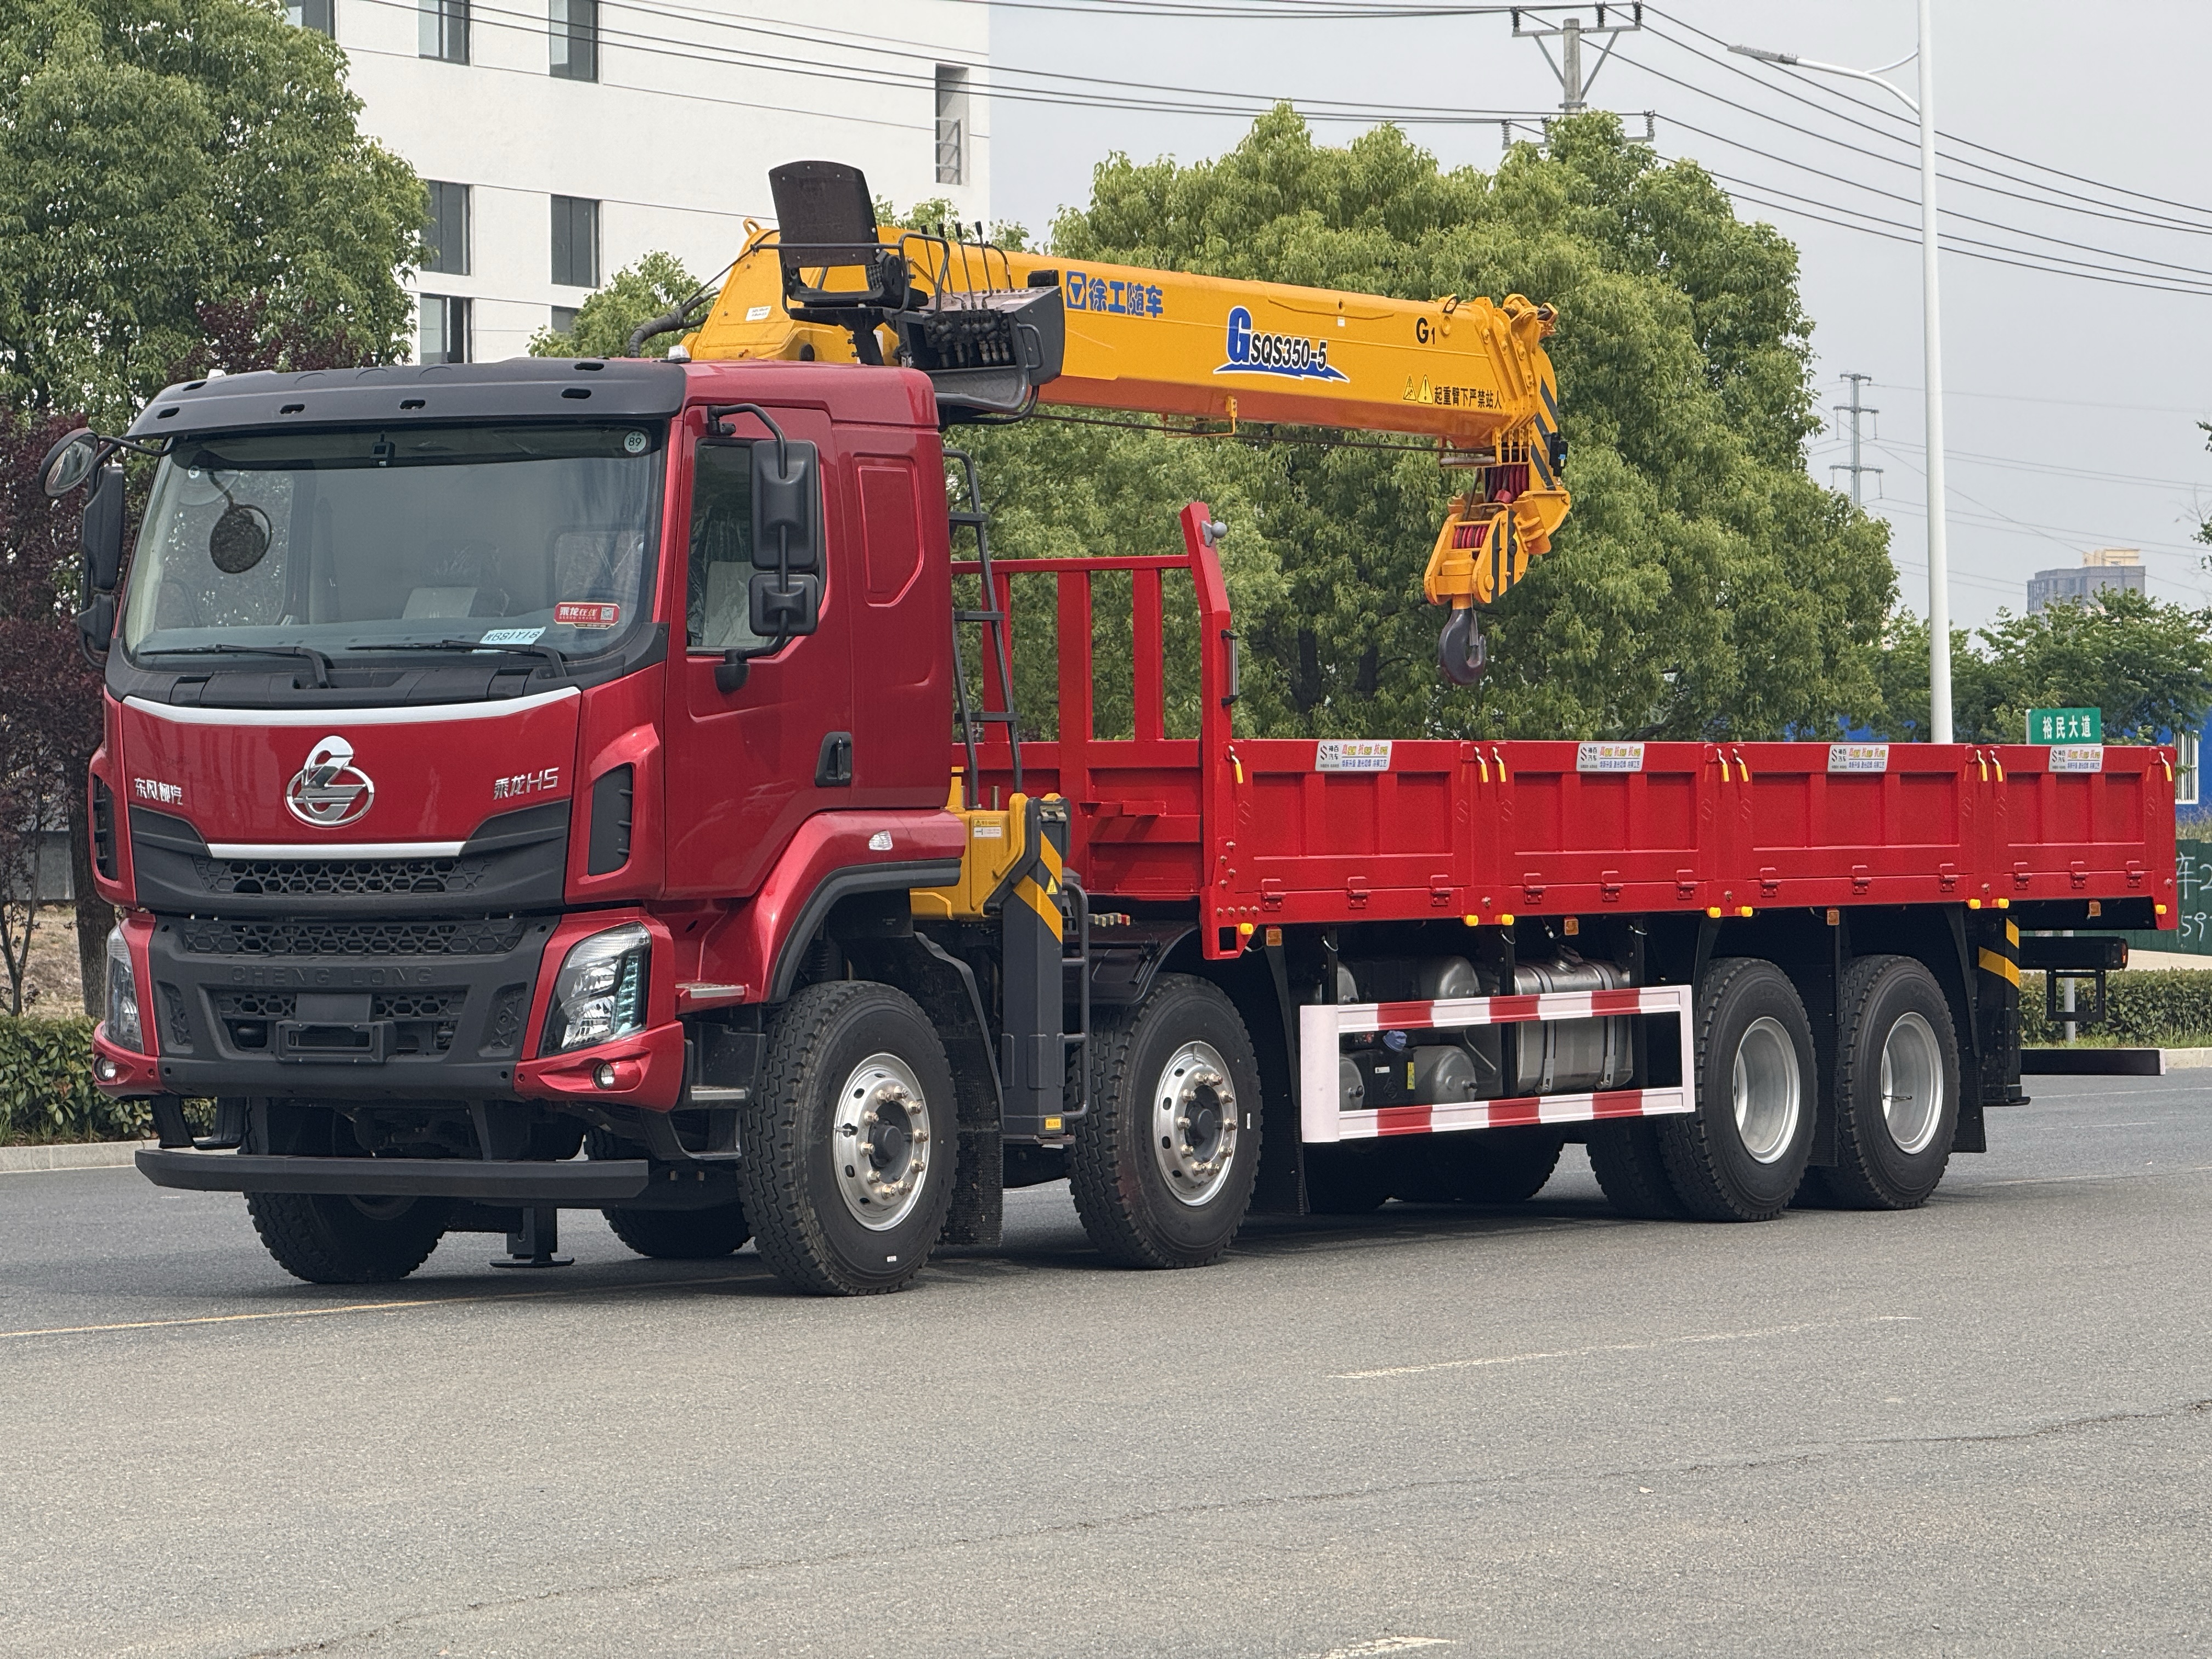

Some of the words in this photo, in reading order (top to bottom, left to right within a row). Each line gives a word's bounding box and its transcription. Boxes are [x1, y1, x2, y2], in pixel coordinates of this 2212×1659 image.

[1088, 278, 1164, 318] 徐工随车
[1434, 385, 1502, 410] 起重臂下严禁站人
[628, 437, 642, 447] 89
[2042, 715, 2092, 740] 裕民大道
[134, 777, 183, 806] 东风柳汽
[2181, 910, 2212, 941] 59
[231, 966, 329, 985] CHENG
[351, 967, 432, 985] LONG
